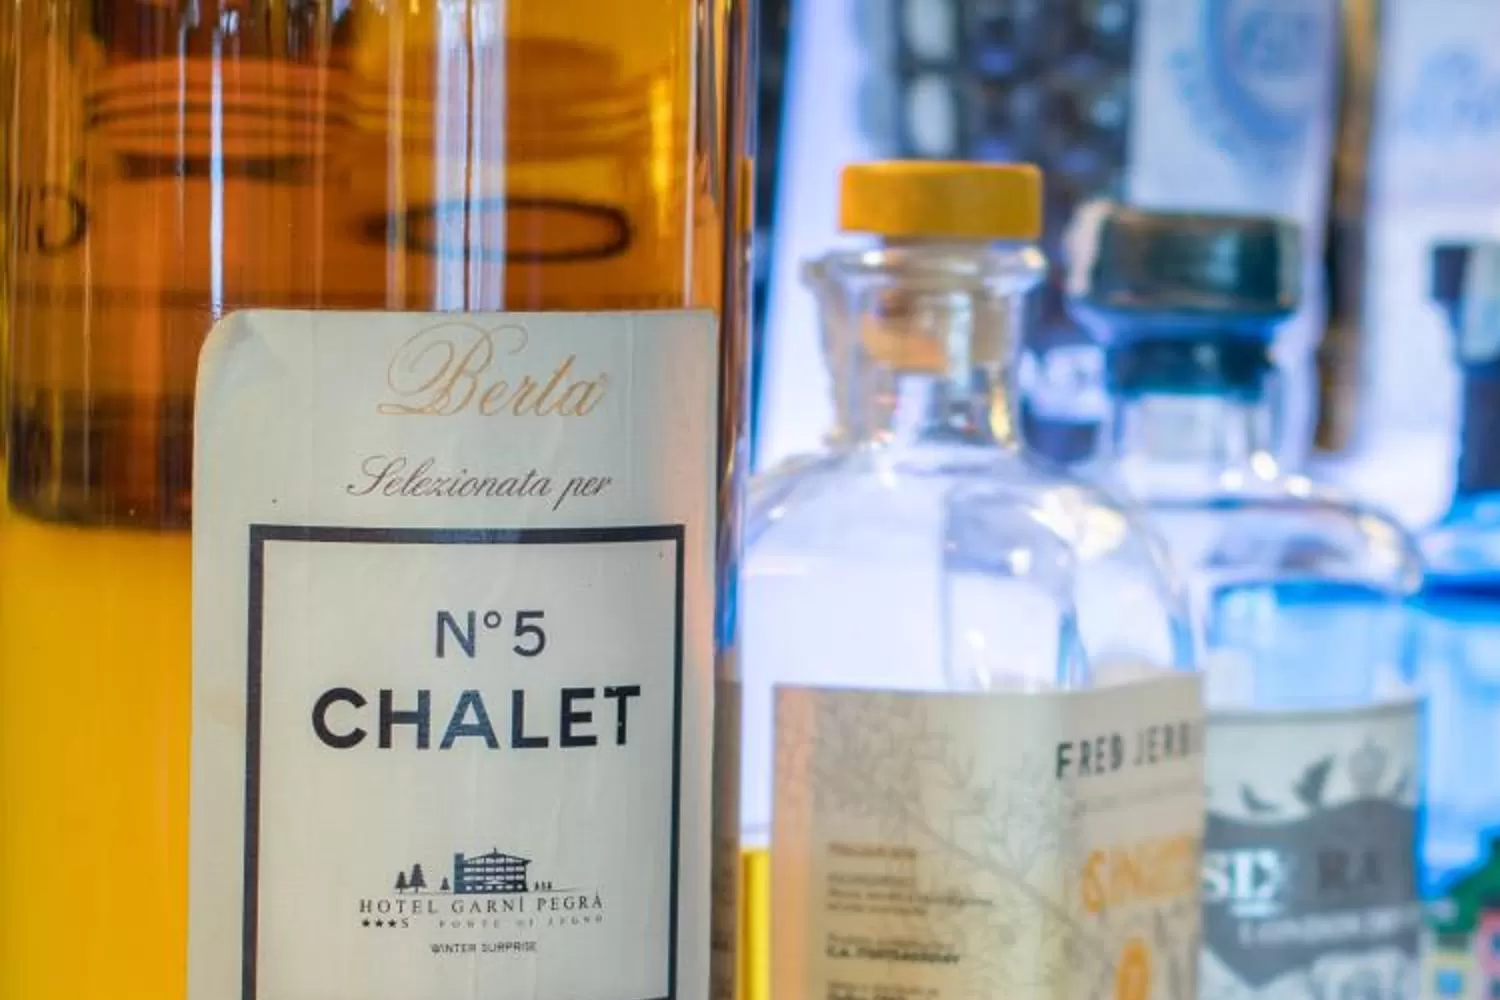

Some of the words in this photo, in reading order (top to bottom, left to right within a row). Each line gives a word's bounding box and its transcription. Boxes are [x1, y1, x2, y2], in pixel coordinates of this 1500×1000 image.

[376, 321, 607, 417] Berta
[346, 455, 552, 497] Selezionata
[553, 476, 613, 511] per
[311, 684, 642, 750] CHALET
[1055, 732, 1124, 780] FRED
[359, 898, 438, 915] HOTEL
